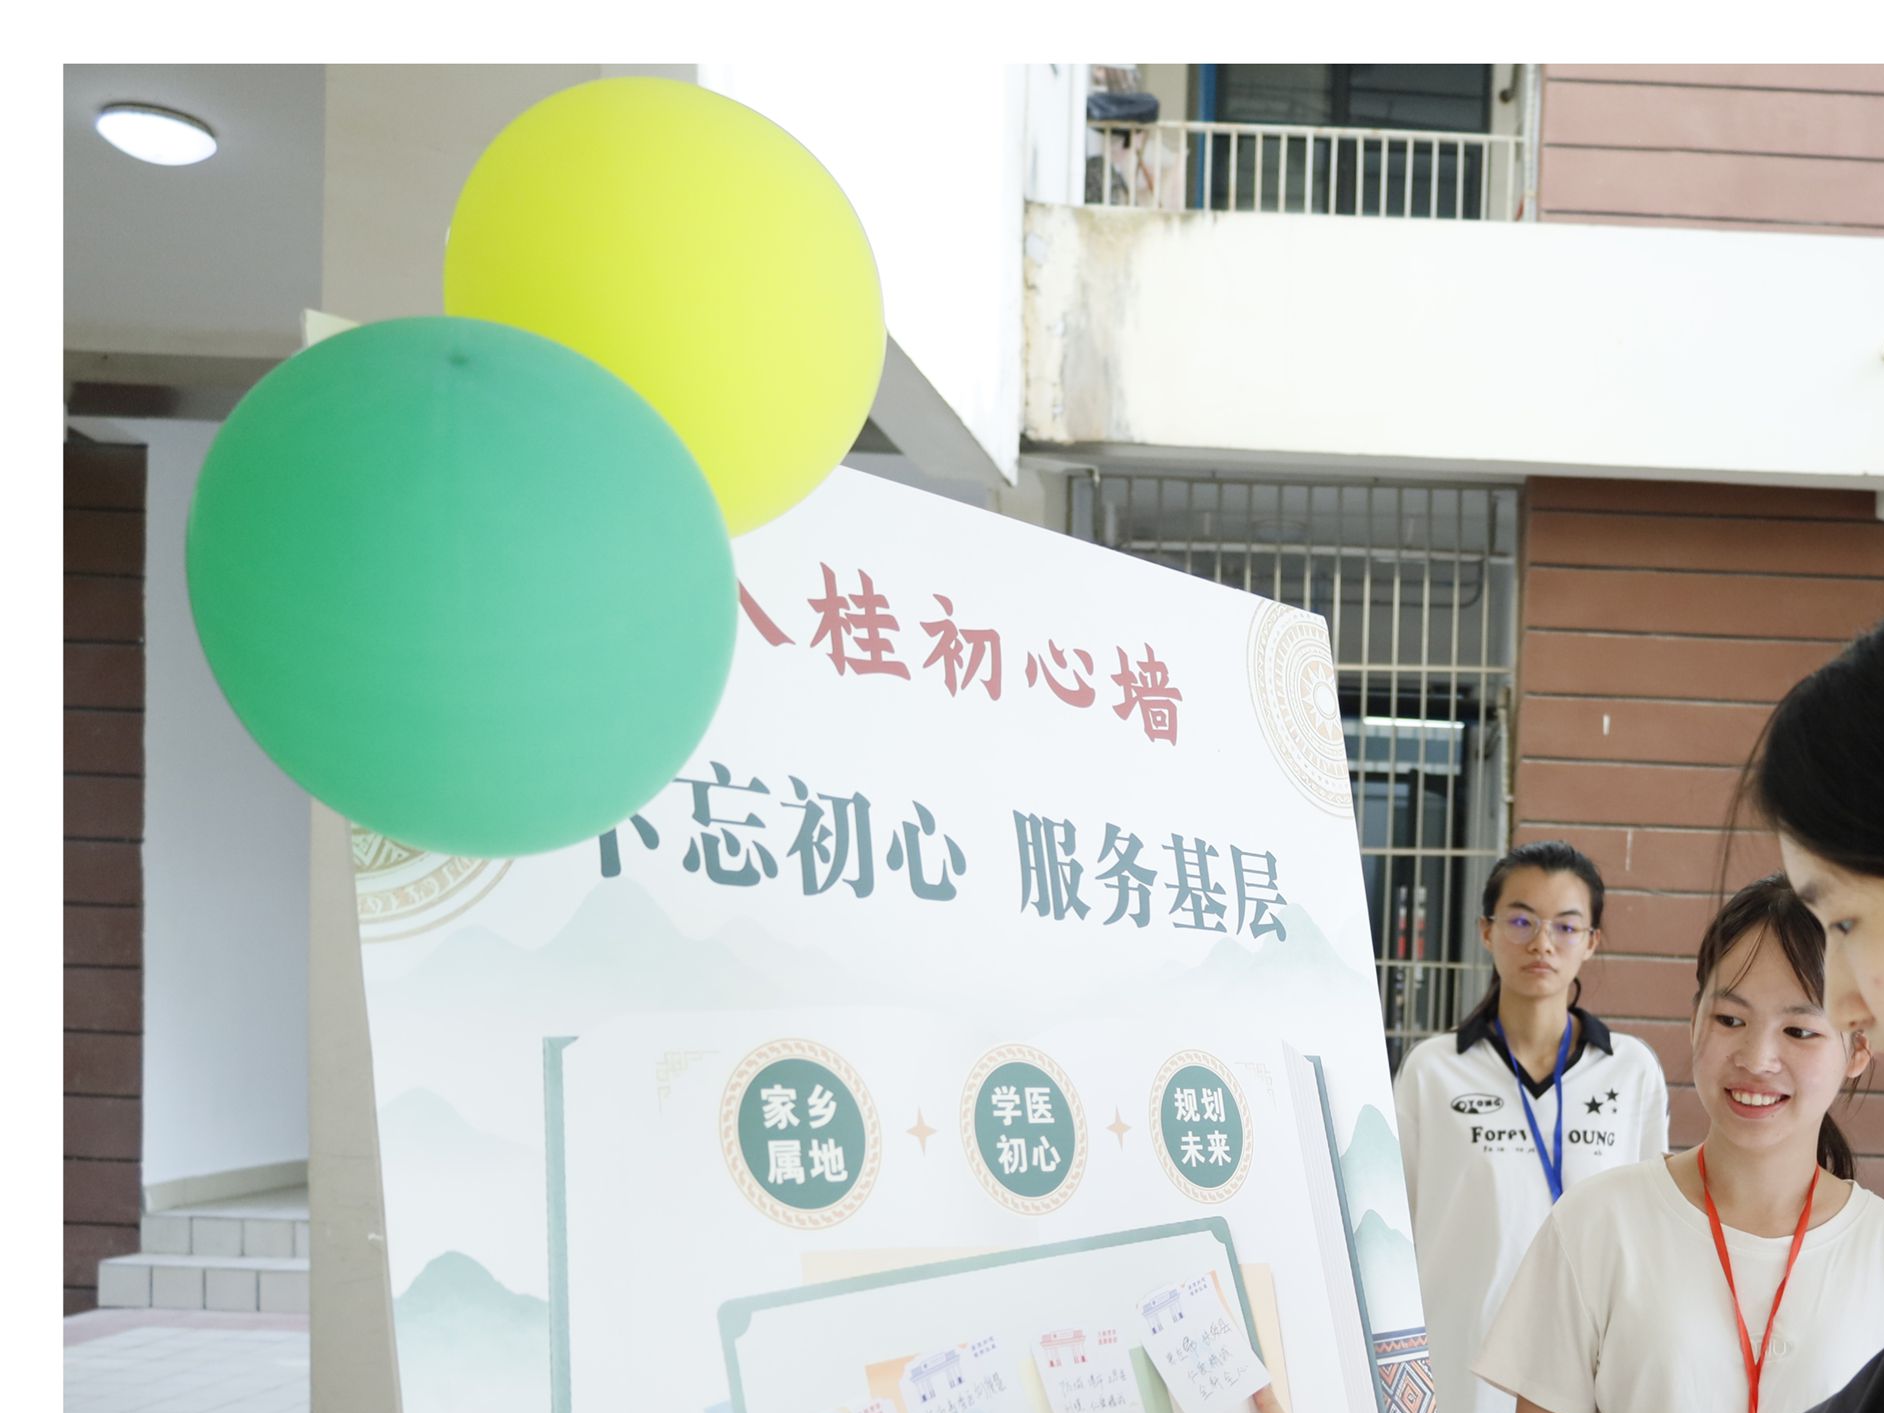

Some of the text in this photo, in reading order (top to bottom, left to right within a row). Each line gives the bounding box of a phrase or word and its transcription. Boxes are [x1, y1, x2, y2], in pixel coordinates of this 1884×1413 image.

[1012, 810, 1289, 942] 服务基层
[760, 1084, 838, 1131] 家乡
[992, 1085, 1056, 1127] 学医
[1174, 1086, 1227, 1123] 规划
[767, 1138, 849, 1186] 属地
[996, 1135, 1062, 1175] 初心
[1181, 1130, 1233, 1168] 未来
